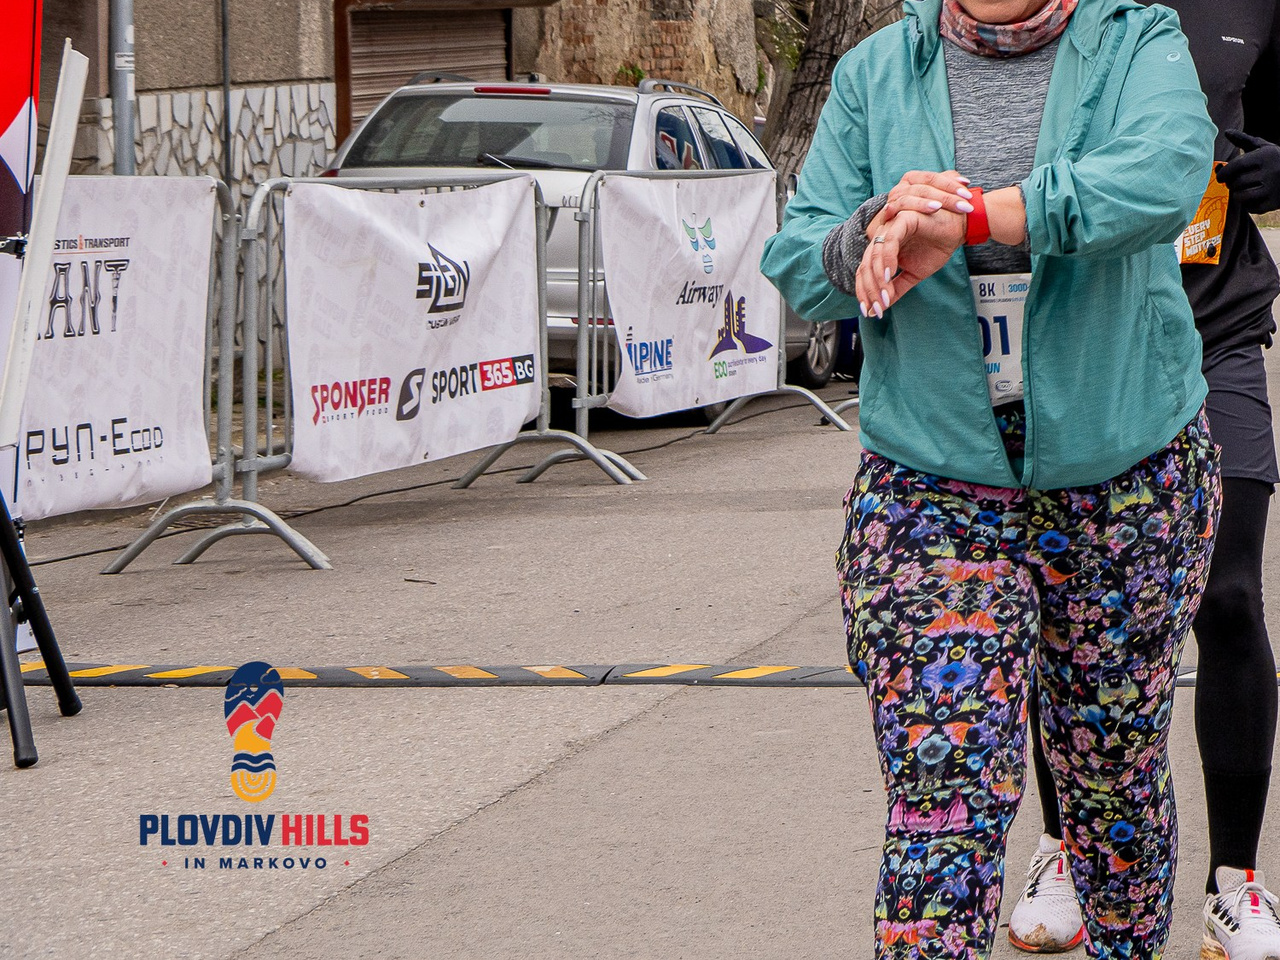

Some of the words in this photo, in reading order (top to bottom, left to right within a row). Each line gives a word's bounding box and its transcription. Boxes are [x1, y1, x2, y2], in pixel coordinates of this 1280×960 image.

[84, 238, 130, 249] TRANSPORT
[980, 283, 996, 297] 8K
[714, 360, 728, 379] ECO
[311, 377, 391, 426] SPONSER
